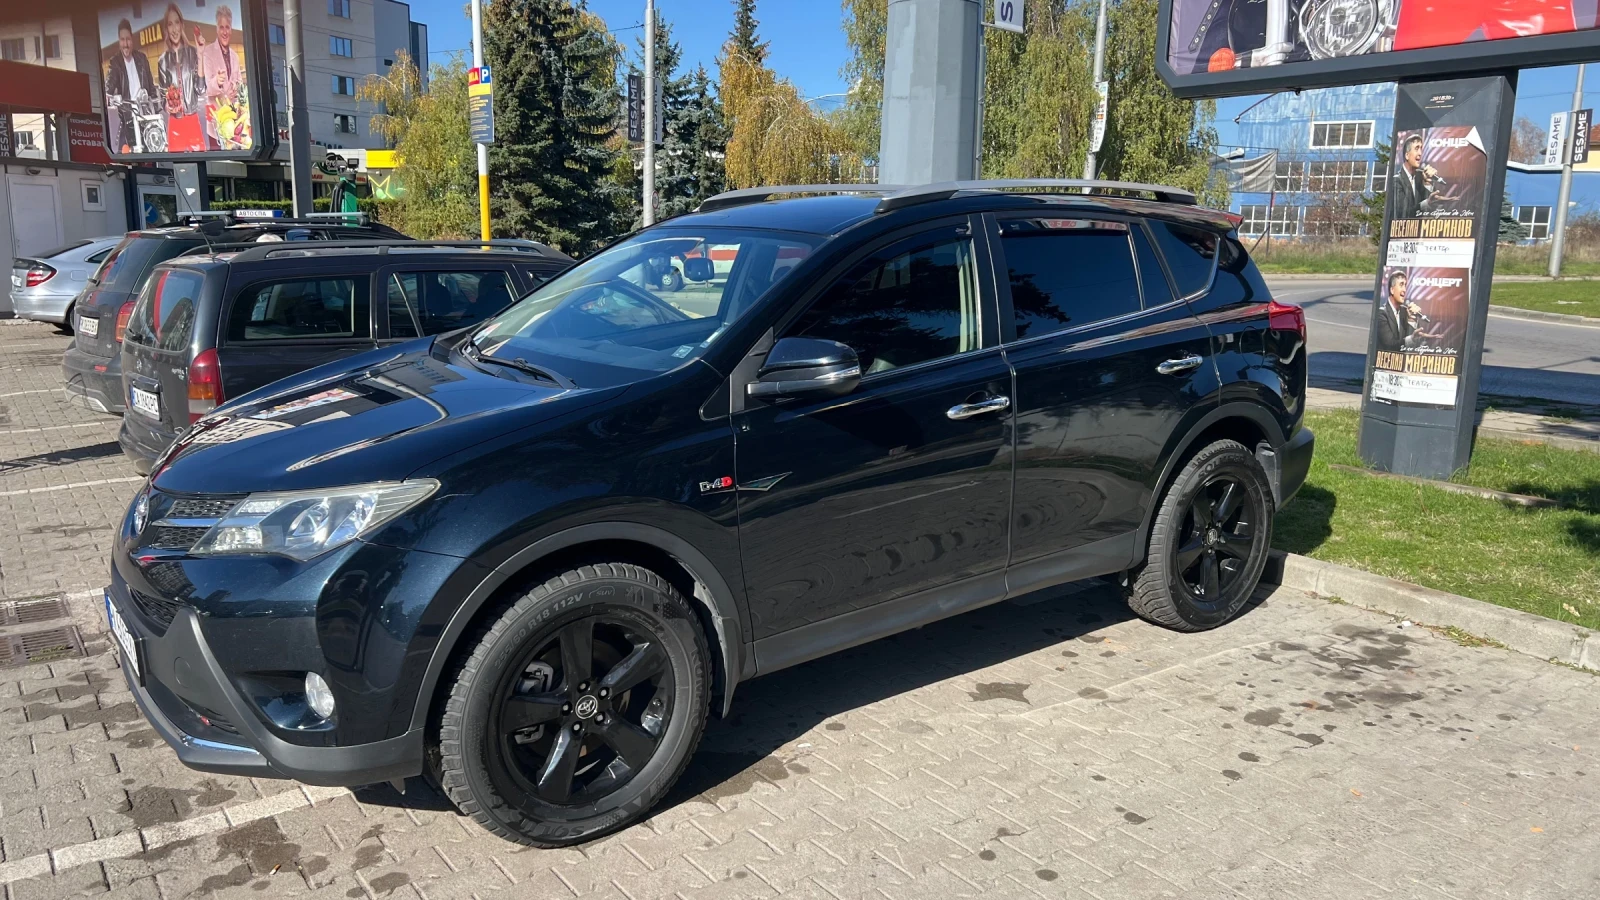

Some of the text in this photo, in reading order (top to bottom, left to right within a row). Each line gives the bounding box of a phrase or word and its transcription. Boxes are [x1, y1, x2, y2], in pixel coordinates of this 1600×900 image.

[140, 24, 162, 45] BILLA
[482, 69, 489, 81] P
[0, 114, 10, 157] SESAME
[1429, 137, 1469, 148] КОНЦЕ
[1549, 117, 1561, 163] SESAME
[1574, 111, 1587, 162] SESAME
[1390, 219, 1472, 238] ВЕСЕЛИН МАРИНОВ
[1413, 277, 1462, 289] КОНЦЕРТ
[1376, 351, 1456, 375] ВЕСЕЛИН МАРИНОВ
[528, 608, 550, 629] R18
[552, 592, 584, 612] 112V
